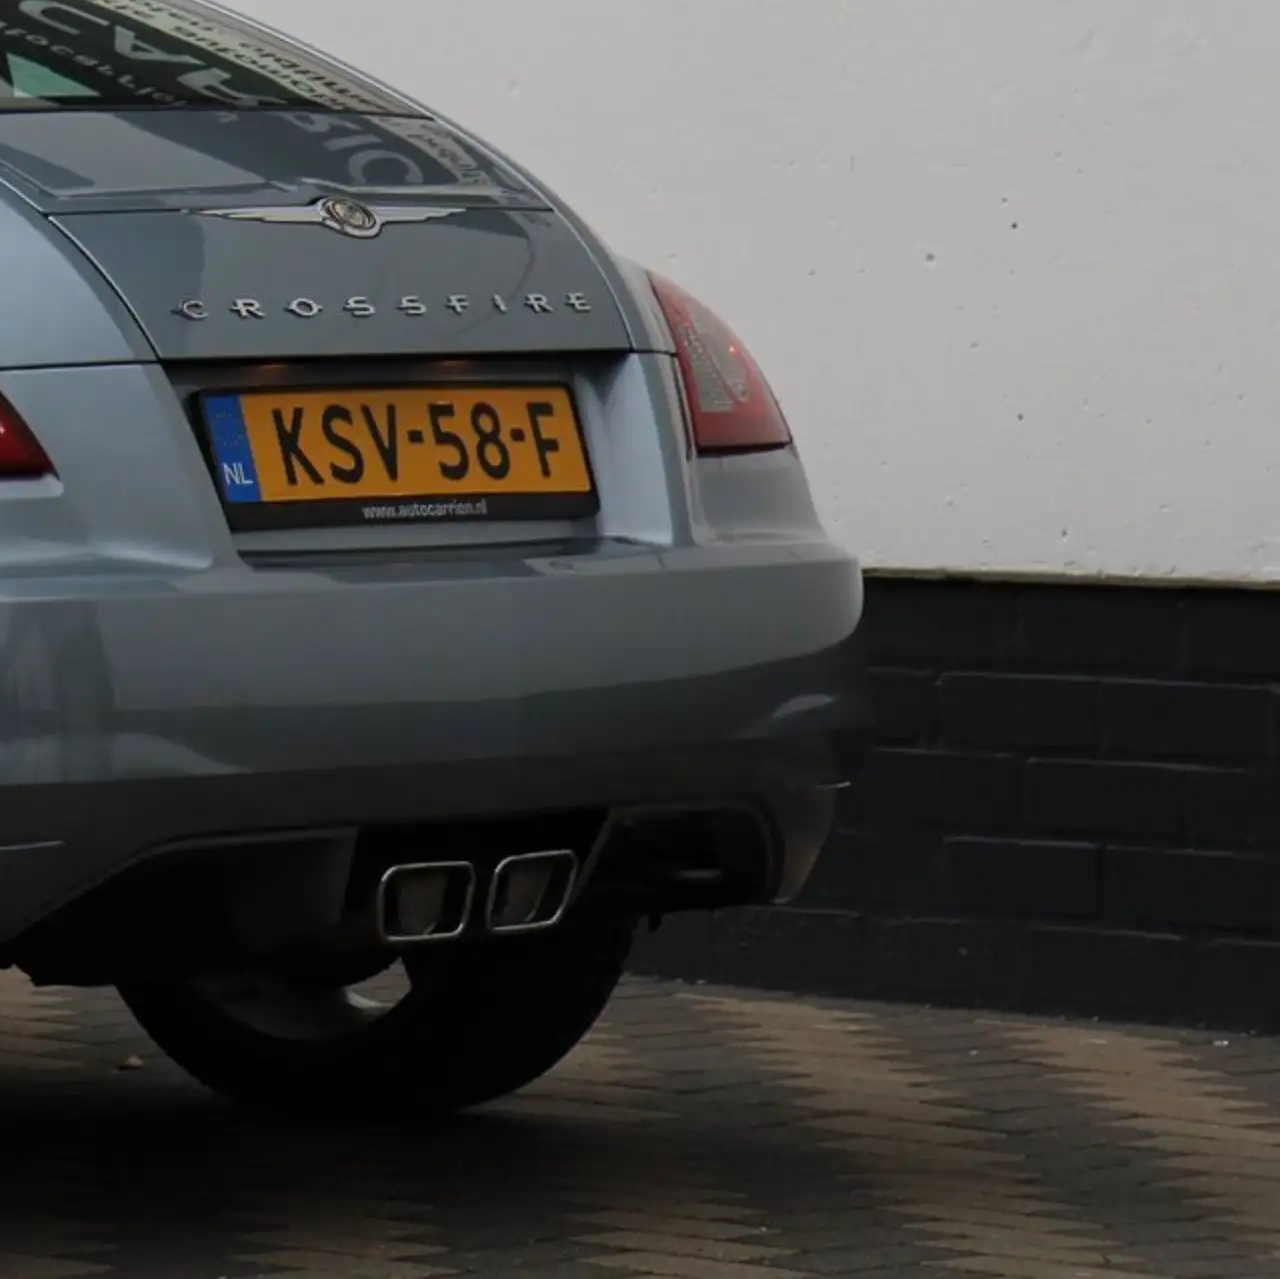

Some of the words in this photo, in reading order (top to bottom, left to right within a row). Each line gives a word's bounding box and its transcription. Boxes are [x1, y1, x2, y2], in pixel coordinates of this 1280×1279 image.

[178, 291, 593, 321] CROSSFIRE
[271, 401, 561, 487] KSV-58-F
[222, 461, 255, 486] NL
[361, 498, 488, 520] www.autocarrion.nl
